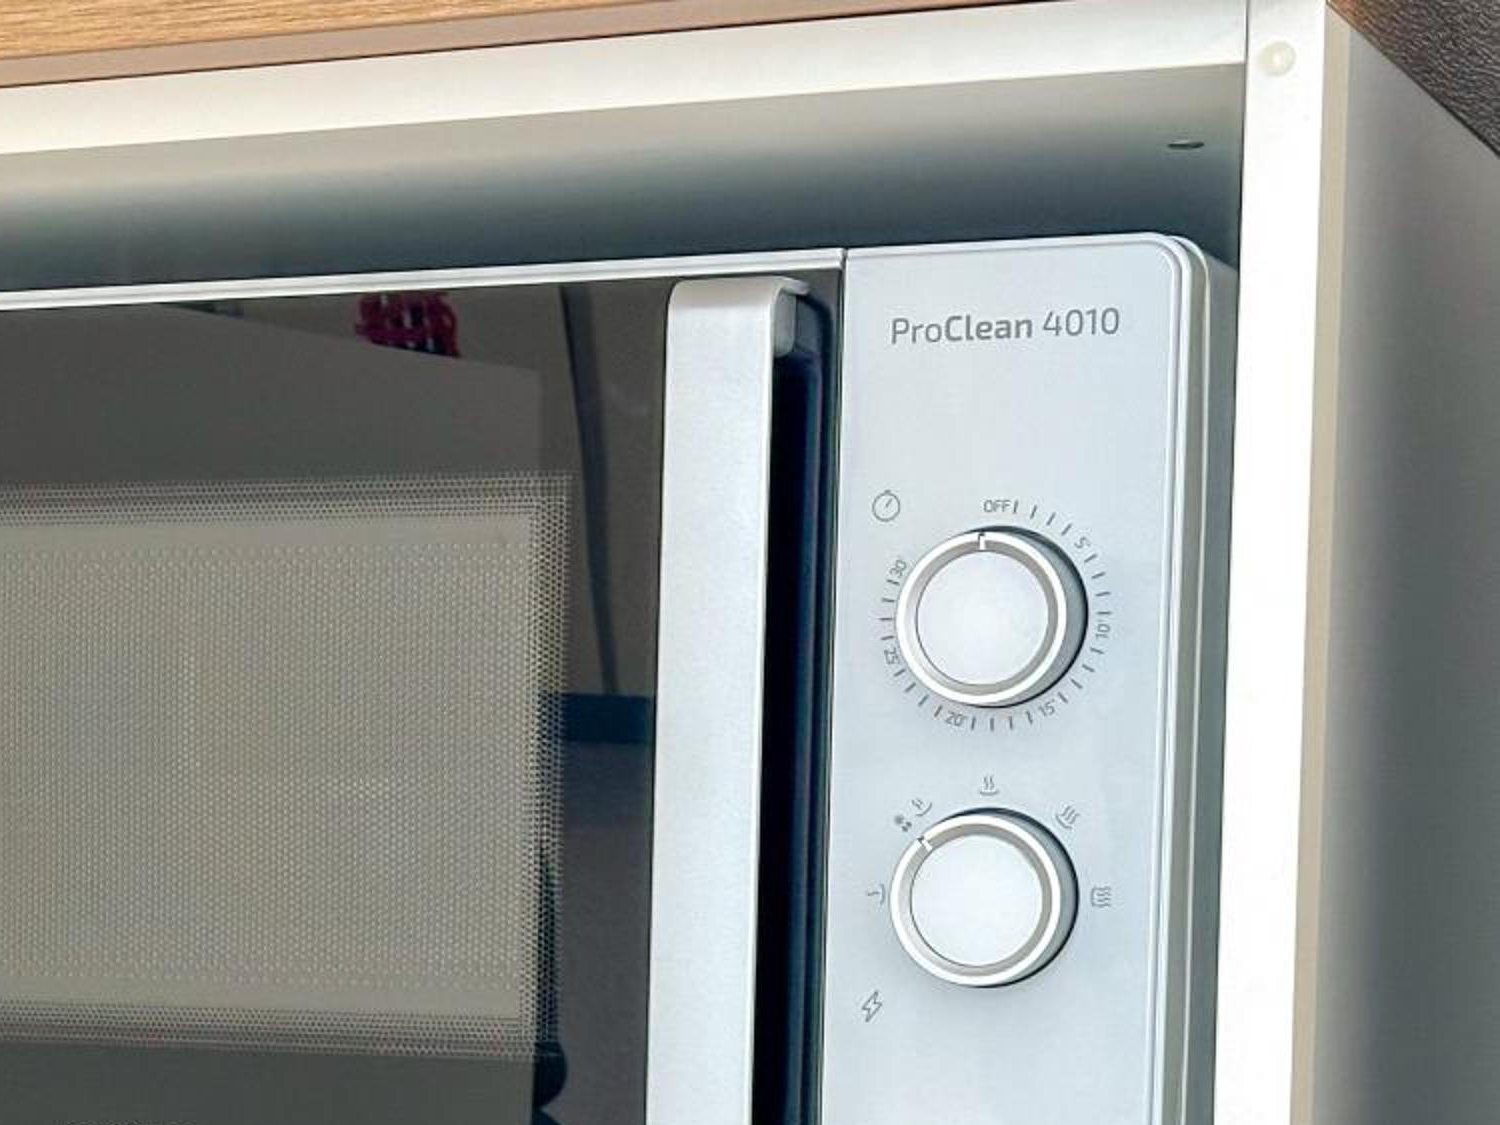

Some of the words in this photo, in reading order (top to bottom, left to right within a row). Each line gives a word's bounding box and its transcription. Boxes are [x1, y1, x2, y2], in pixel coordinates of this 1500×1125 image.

[891, 314, 1033, 344] ProClean
[1043, 307, 1120, 337] 4010
[983, 499, 1011, 513] OFF
